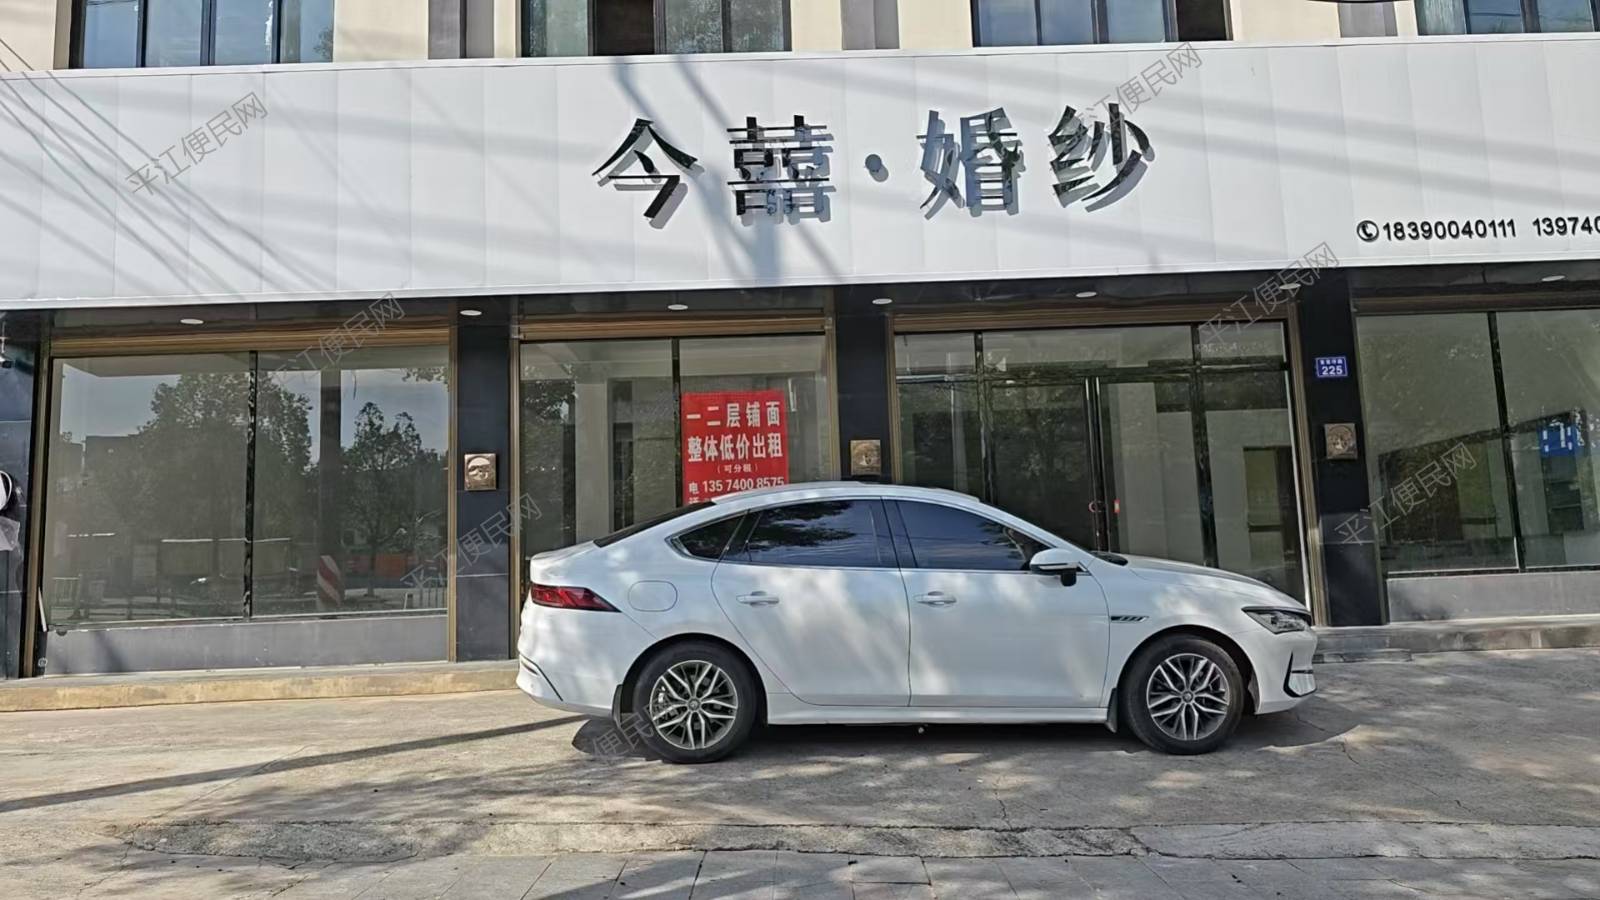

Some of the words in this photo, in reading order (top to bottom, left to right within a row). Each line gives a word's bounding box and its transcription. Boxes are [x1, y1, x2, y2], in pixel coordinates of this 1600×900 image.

[1383, 218, 1516, 241] 18390040111
[1321, 365, 1343, 375] 225
[686, 401, 780, 428] 一二层铺面
[687, 433, 783, 462] 整体低价出租
[702, 479, 723, 493] 135
[726, 478, 754, 492] 7400
